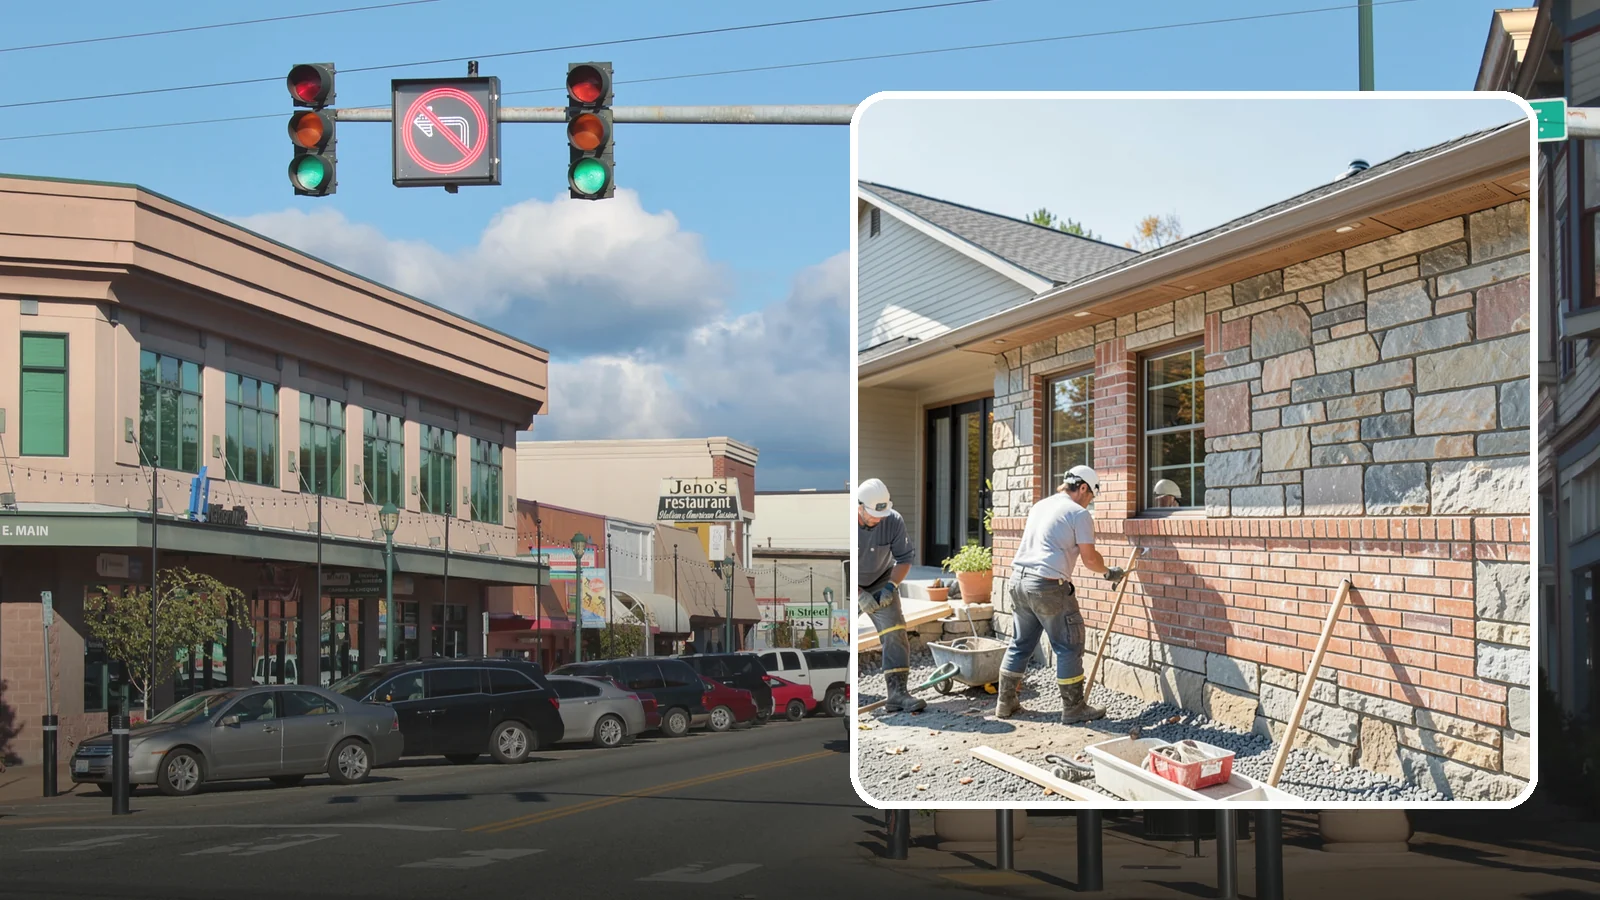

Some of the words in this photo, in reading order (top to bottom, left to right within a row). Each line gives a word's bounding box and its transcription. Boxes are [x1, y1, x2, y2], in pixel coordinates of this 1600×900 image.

[670, 480, 727, 494] Jeno's
[665, 496, 731, 509] restaurant
[658, 509, 681, 519] Italian
[686, 509, 715, 519] American
[715, 509, 738, 519] Cuisine
[2, 525, 13, 536] E.
[15, 525, 49, 536] MAIN
[797, 608, 828, 616] Street
